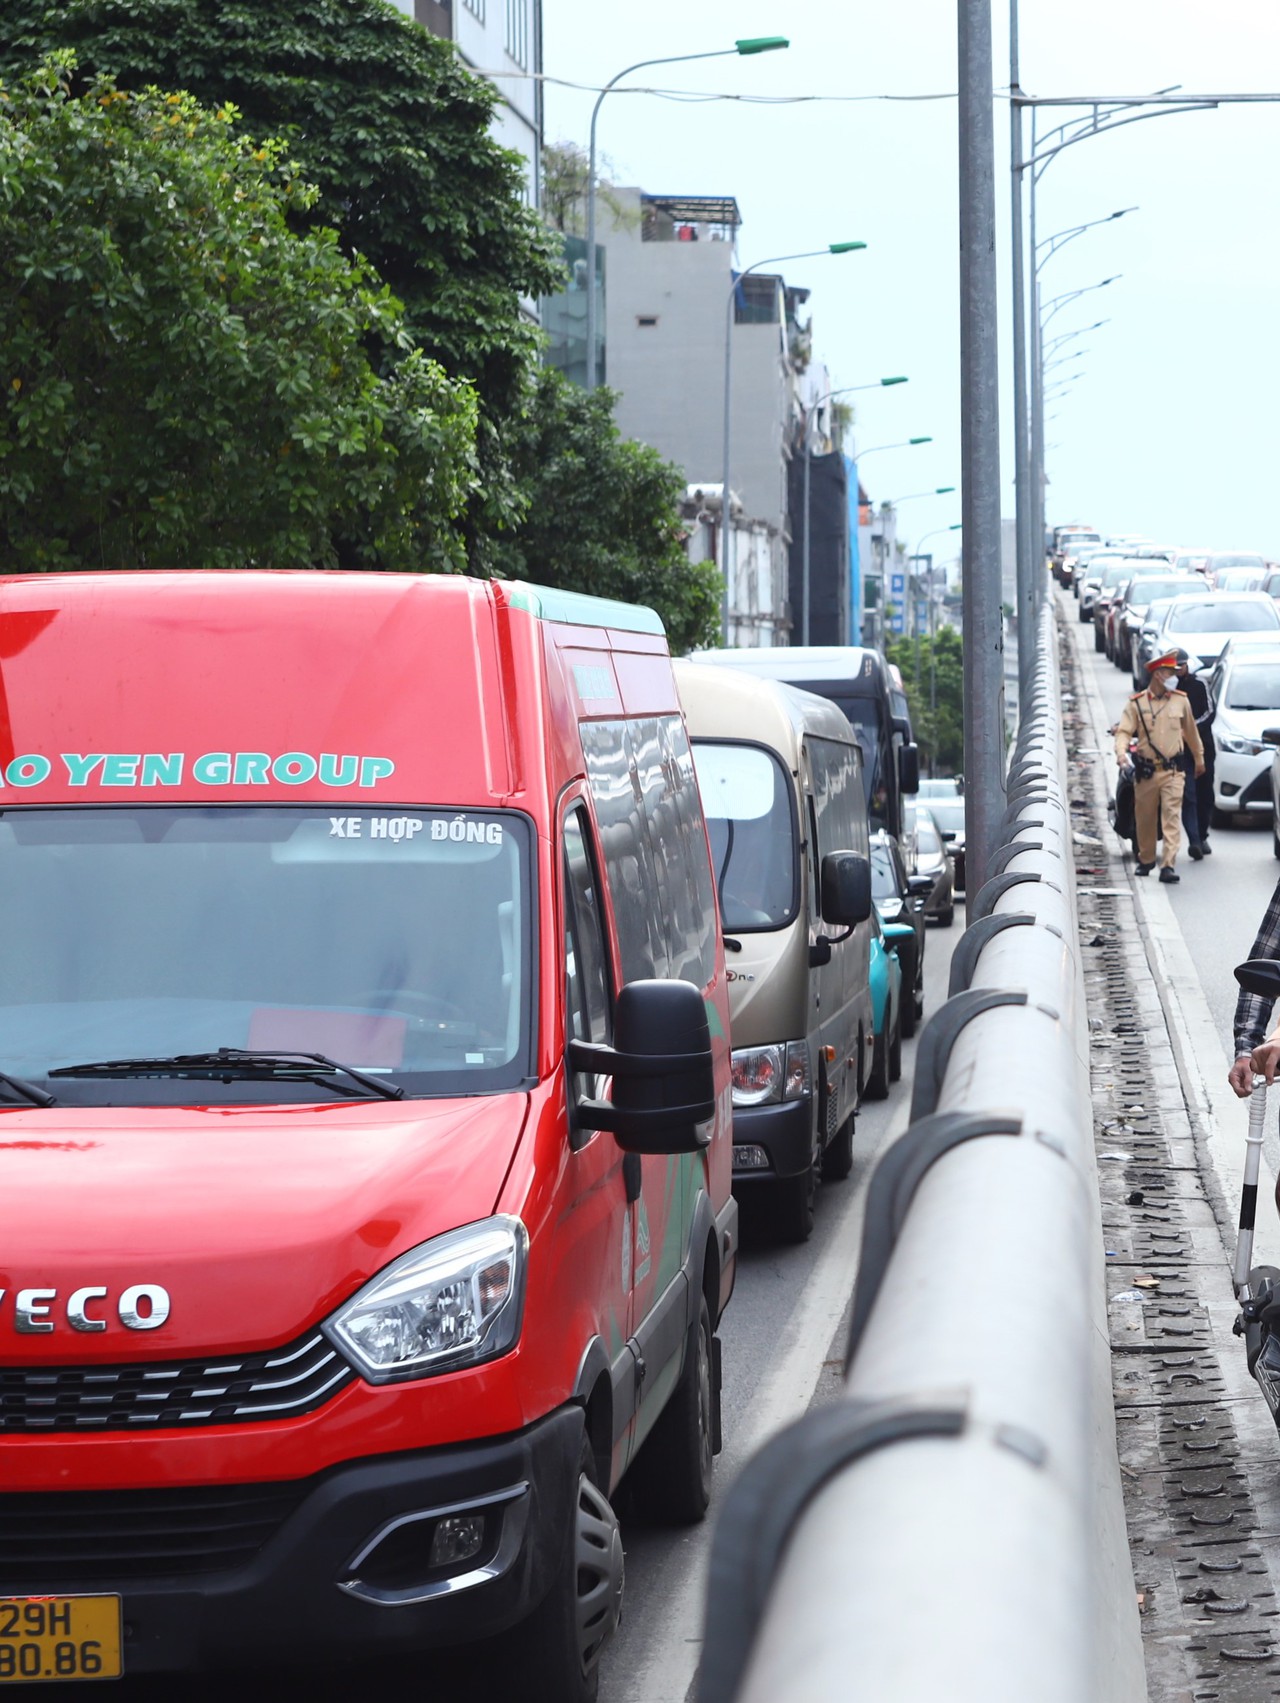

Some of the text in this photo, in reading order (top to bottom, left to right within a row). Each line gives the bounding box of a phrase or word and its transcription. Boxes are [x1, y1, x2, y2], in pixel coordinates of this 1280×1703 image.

[0, 751, 395, 788] O YEN GROUP
[329, 813, 503, 845] XE HỢP ĐỒNG
[0, 1283, 171, 1334] ECO
[0, 1602, 71, 1637] 29H
